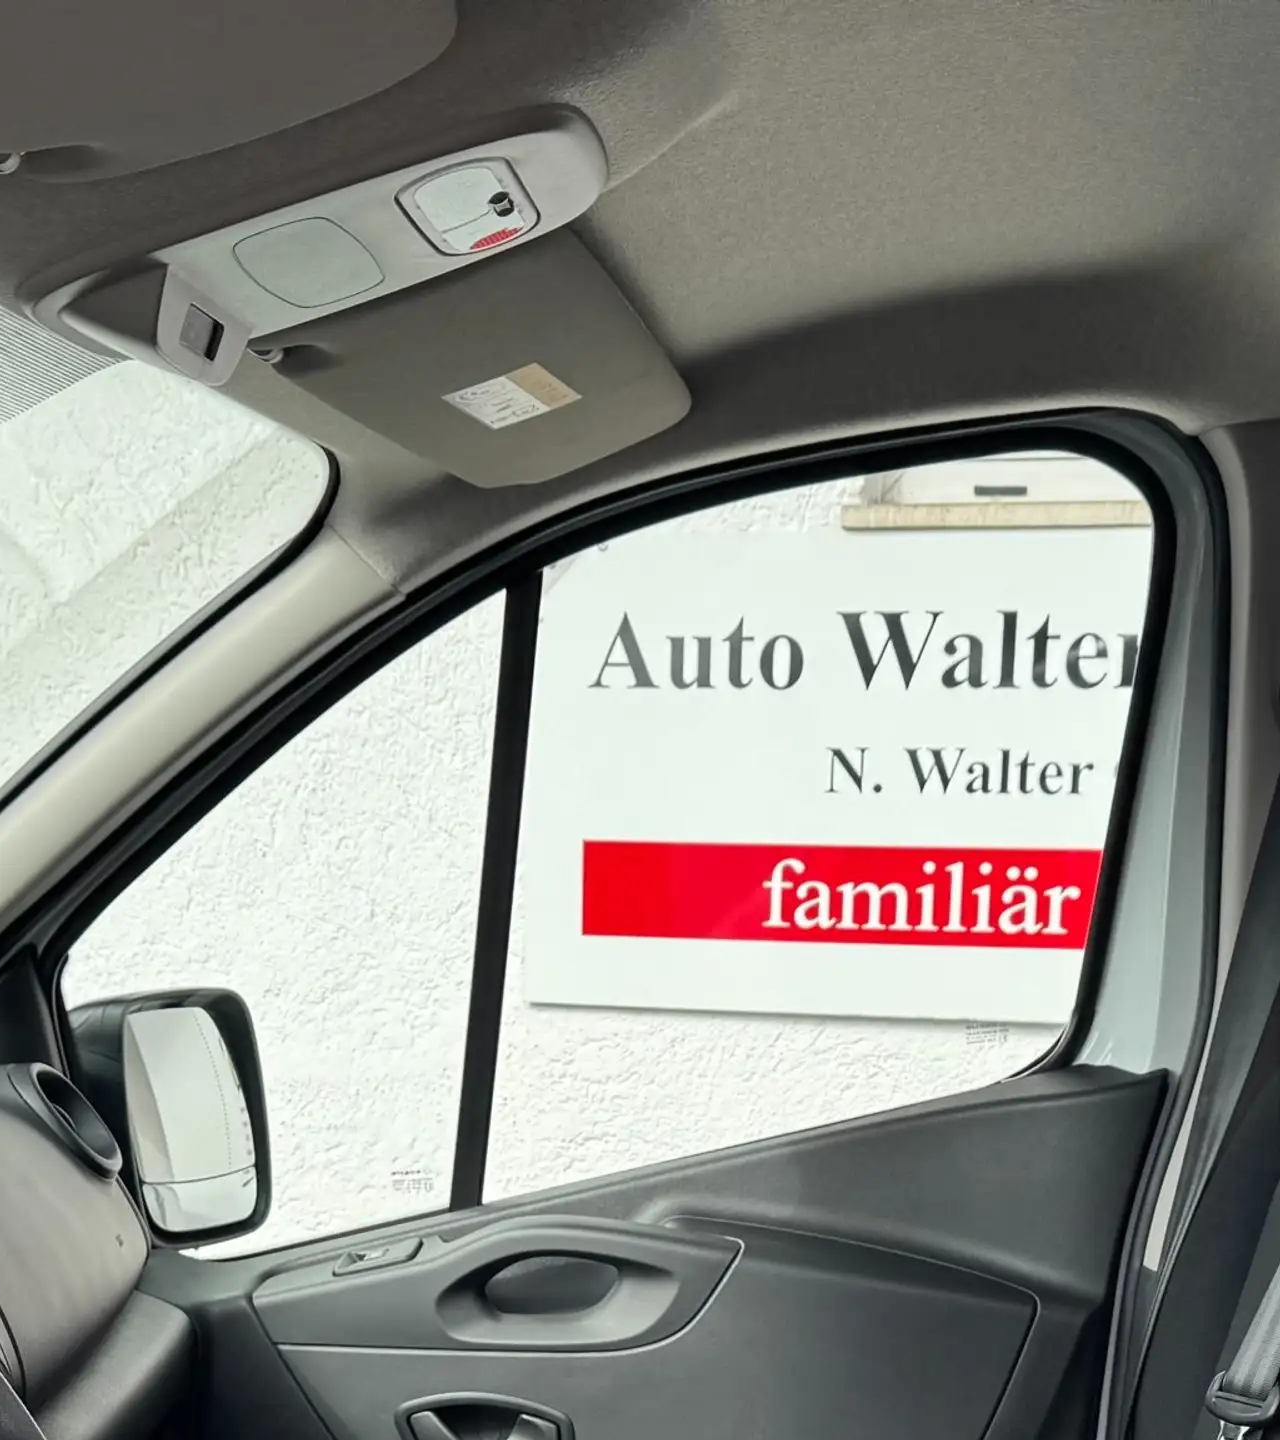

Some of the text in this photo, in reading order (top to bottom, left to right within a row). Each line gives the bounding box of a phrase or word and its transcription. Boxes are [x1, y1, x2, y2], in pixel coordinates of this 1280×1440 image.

[587, 610, 804, 692] Auto
[824, 747, 1094, 795] N. Walter
[761, 857, 1081, 936] familiär
